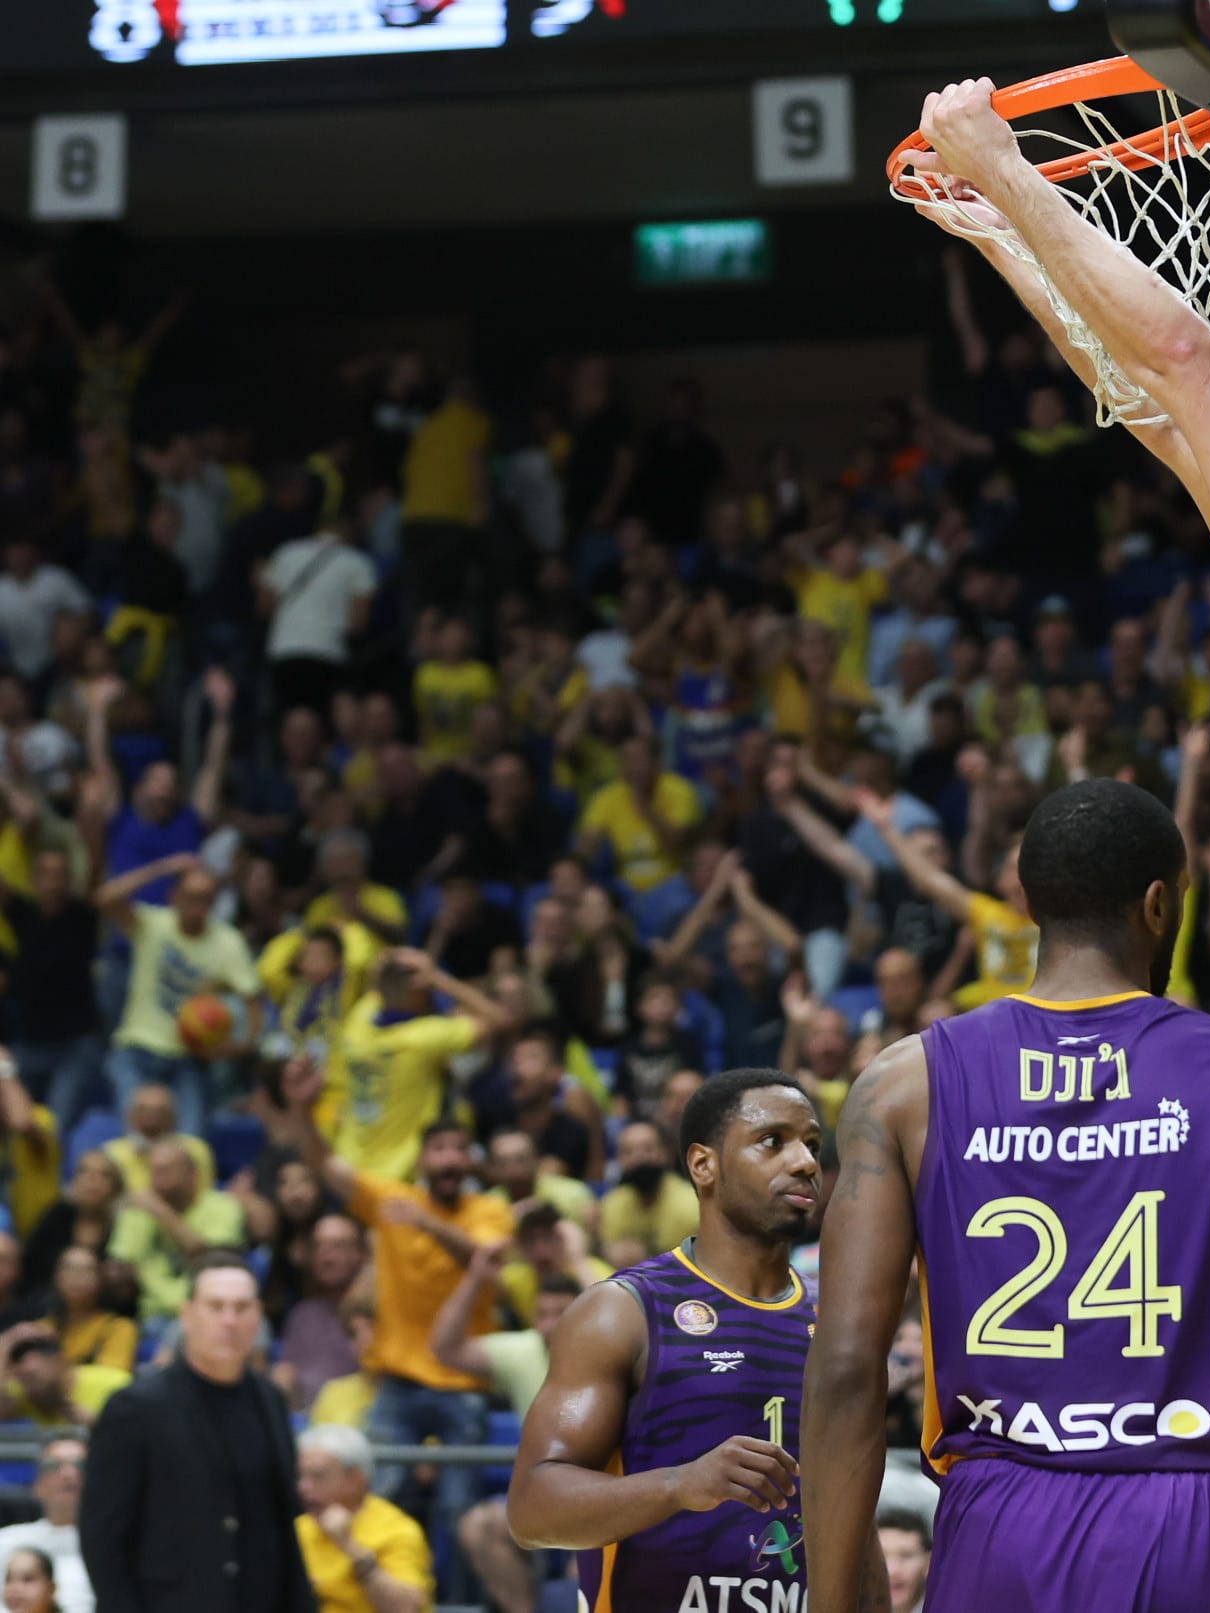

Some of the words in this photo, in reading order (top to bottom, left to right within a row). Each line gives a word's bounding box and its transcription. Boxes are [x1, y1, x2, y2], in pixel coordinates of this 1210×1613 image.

[781, 97, 824, 163] 9
[58, 135, 99, 199] 8
[963, 1126, 1053, 1162] AUTO
[1057, 1117, 1181, 1162] CENTER
[965, 1190, 1182, 1359] 24
[703, 1350, 746, 1361] Reebok
[763, 1396, 786, 1449] 1
